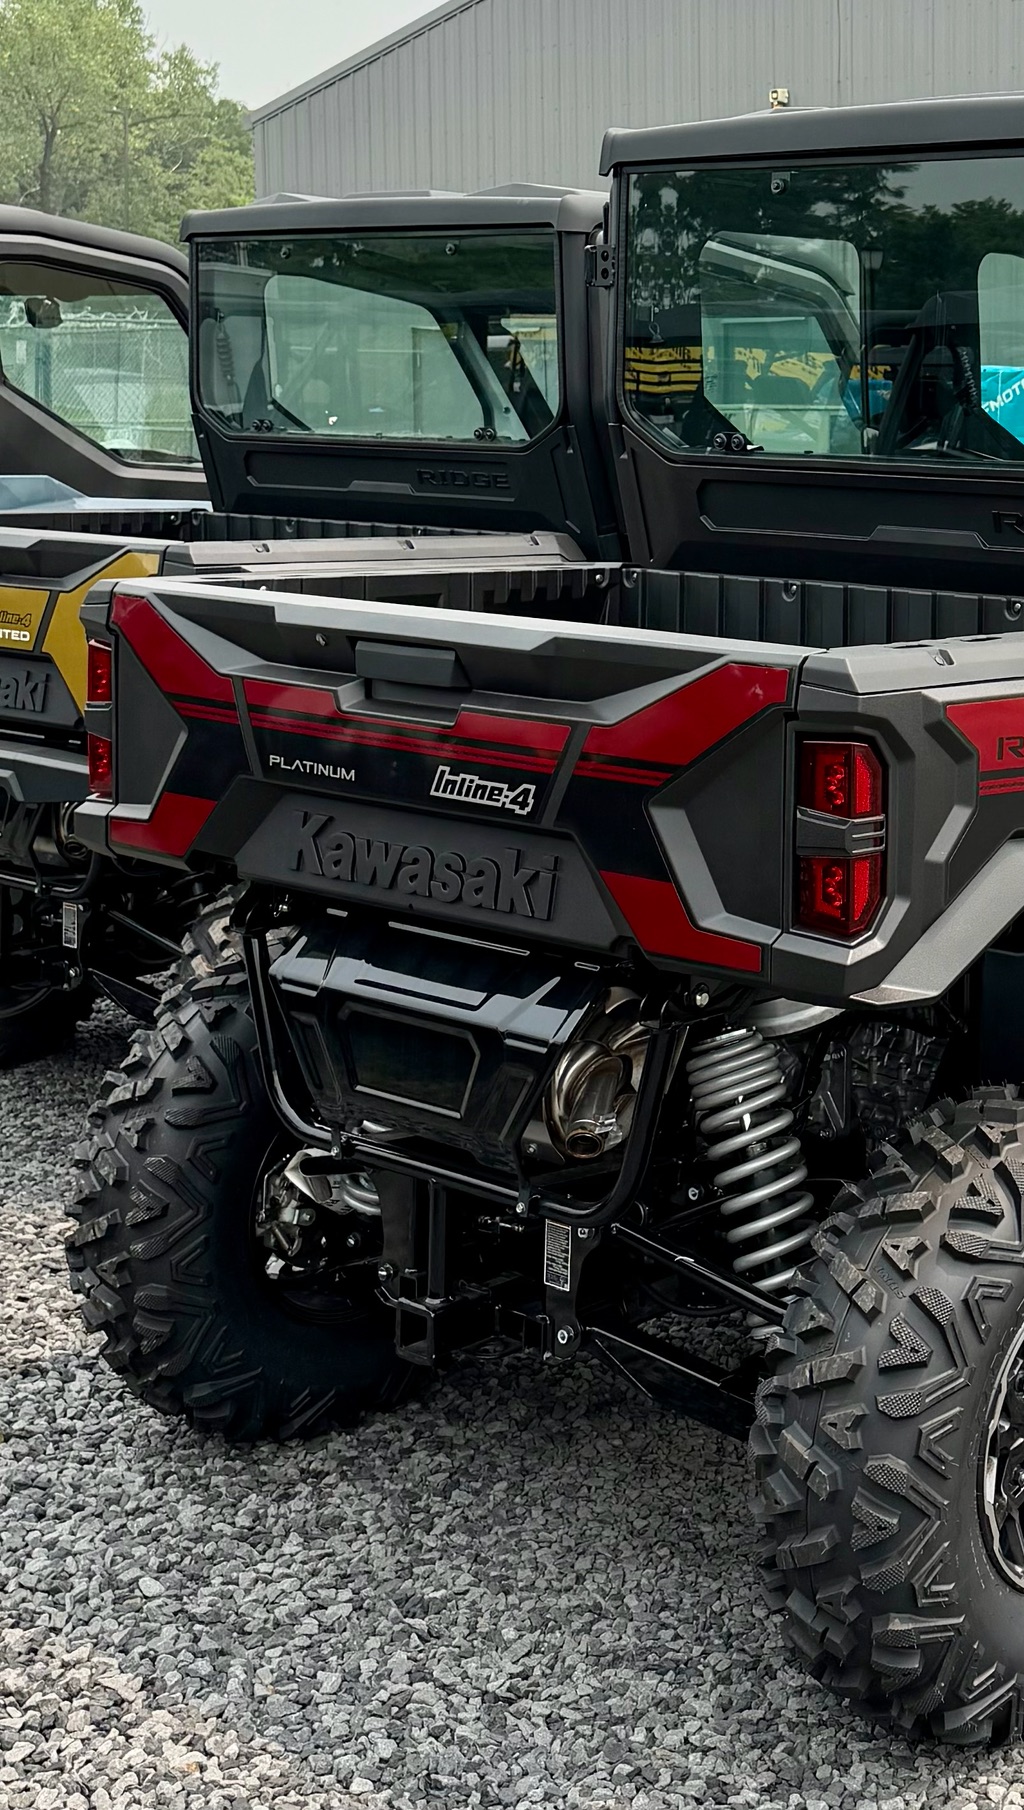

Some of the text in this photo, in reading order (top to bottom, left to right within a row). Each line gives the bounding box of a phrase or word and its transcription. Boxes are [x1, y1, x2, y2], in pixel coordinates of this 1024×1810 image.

[416, 468, 511, 488] RIDGE
[269, 754, 356, 782] PLATINUM
[430, 764, 536, 816] Inline-4
[290, 809, 560, 922] Kawasaki
